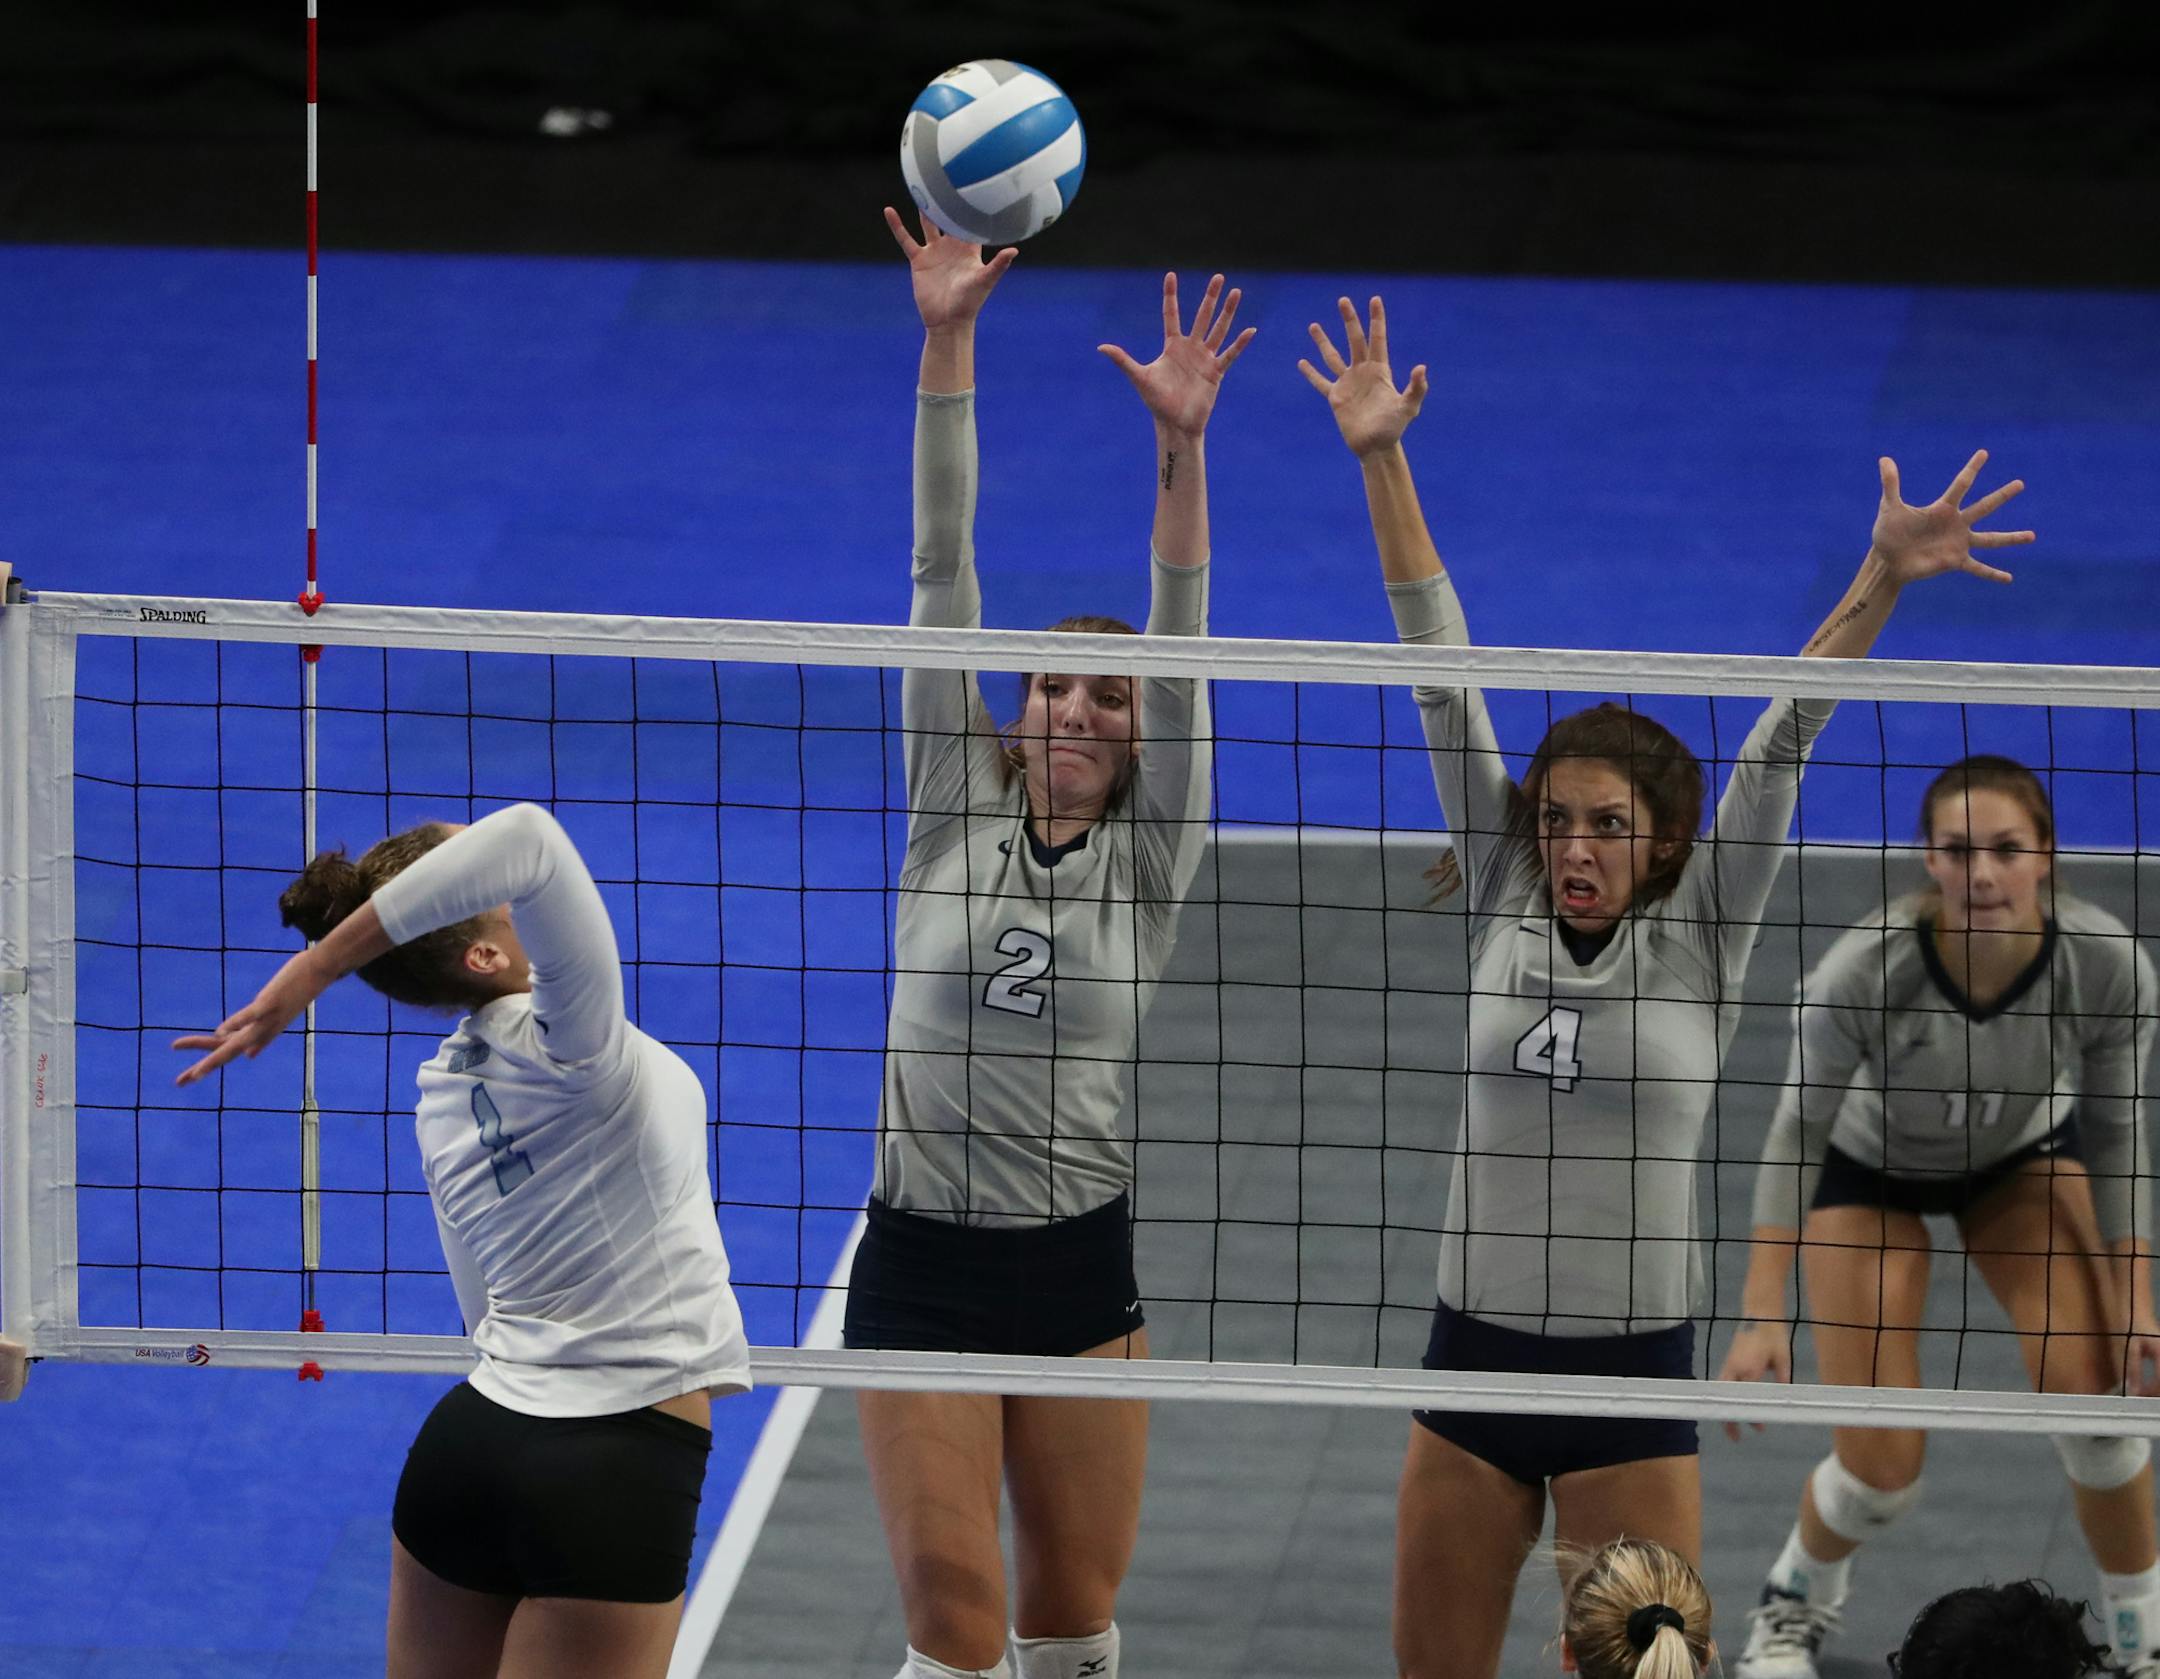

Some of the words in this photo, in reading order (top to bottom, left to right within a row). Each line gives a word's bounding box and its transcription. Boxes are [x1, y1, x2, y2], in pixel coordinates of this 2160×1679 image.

[140, 607, 207, 625] SPALDING
[982, 927, 1053, 1019] 2
[1513, 1005, 1582, 1094] 4
[1942, 1088, 2008, 1128] 11
[135, 1348, 151, 1358] USA
